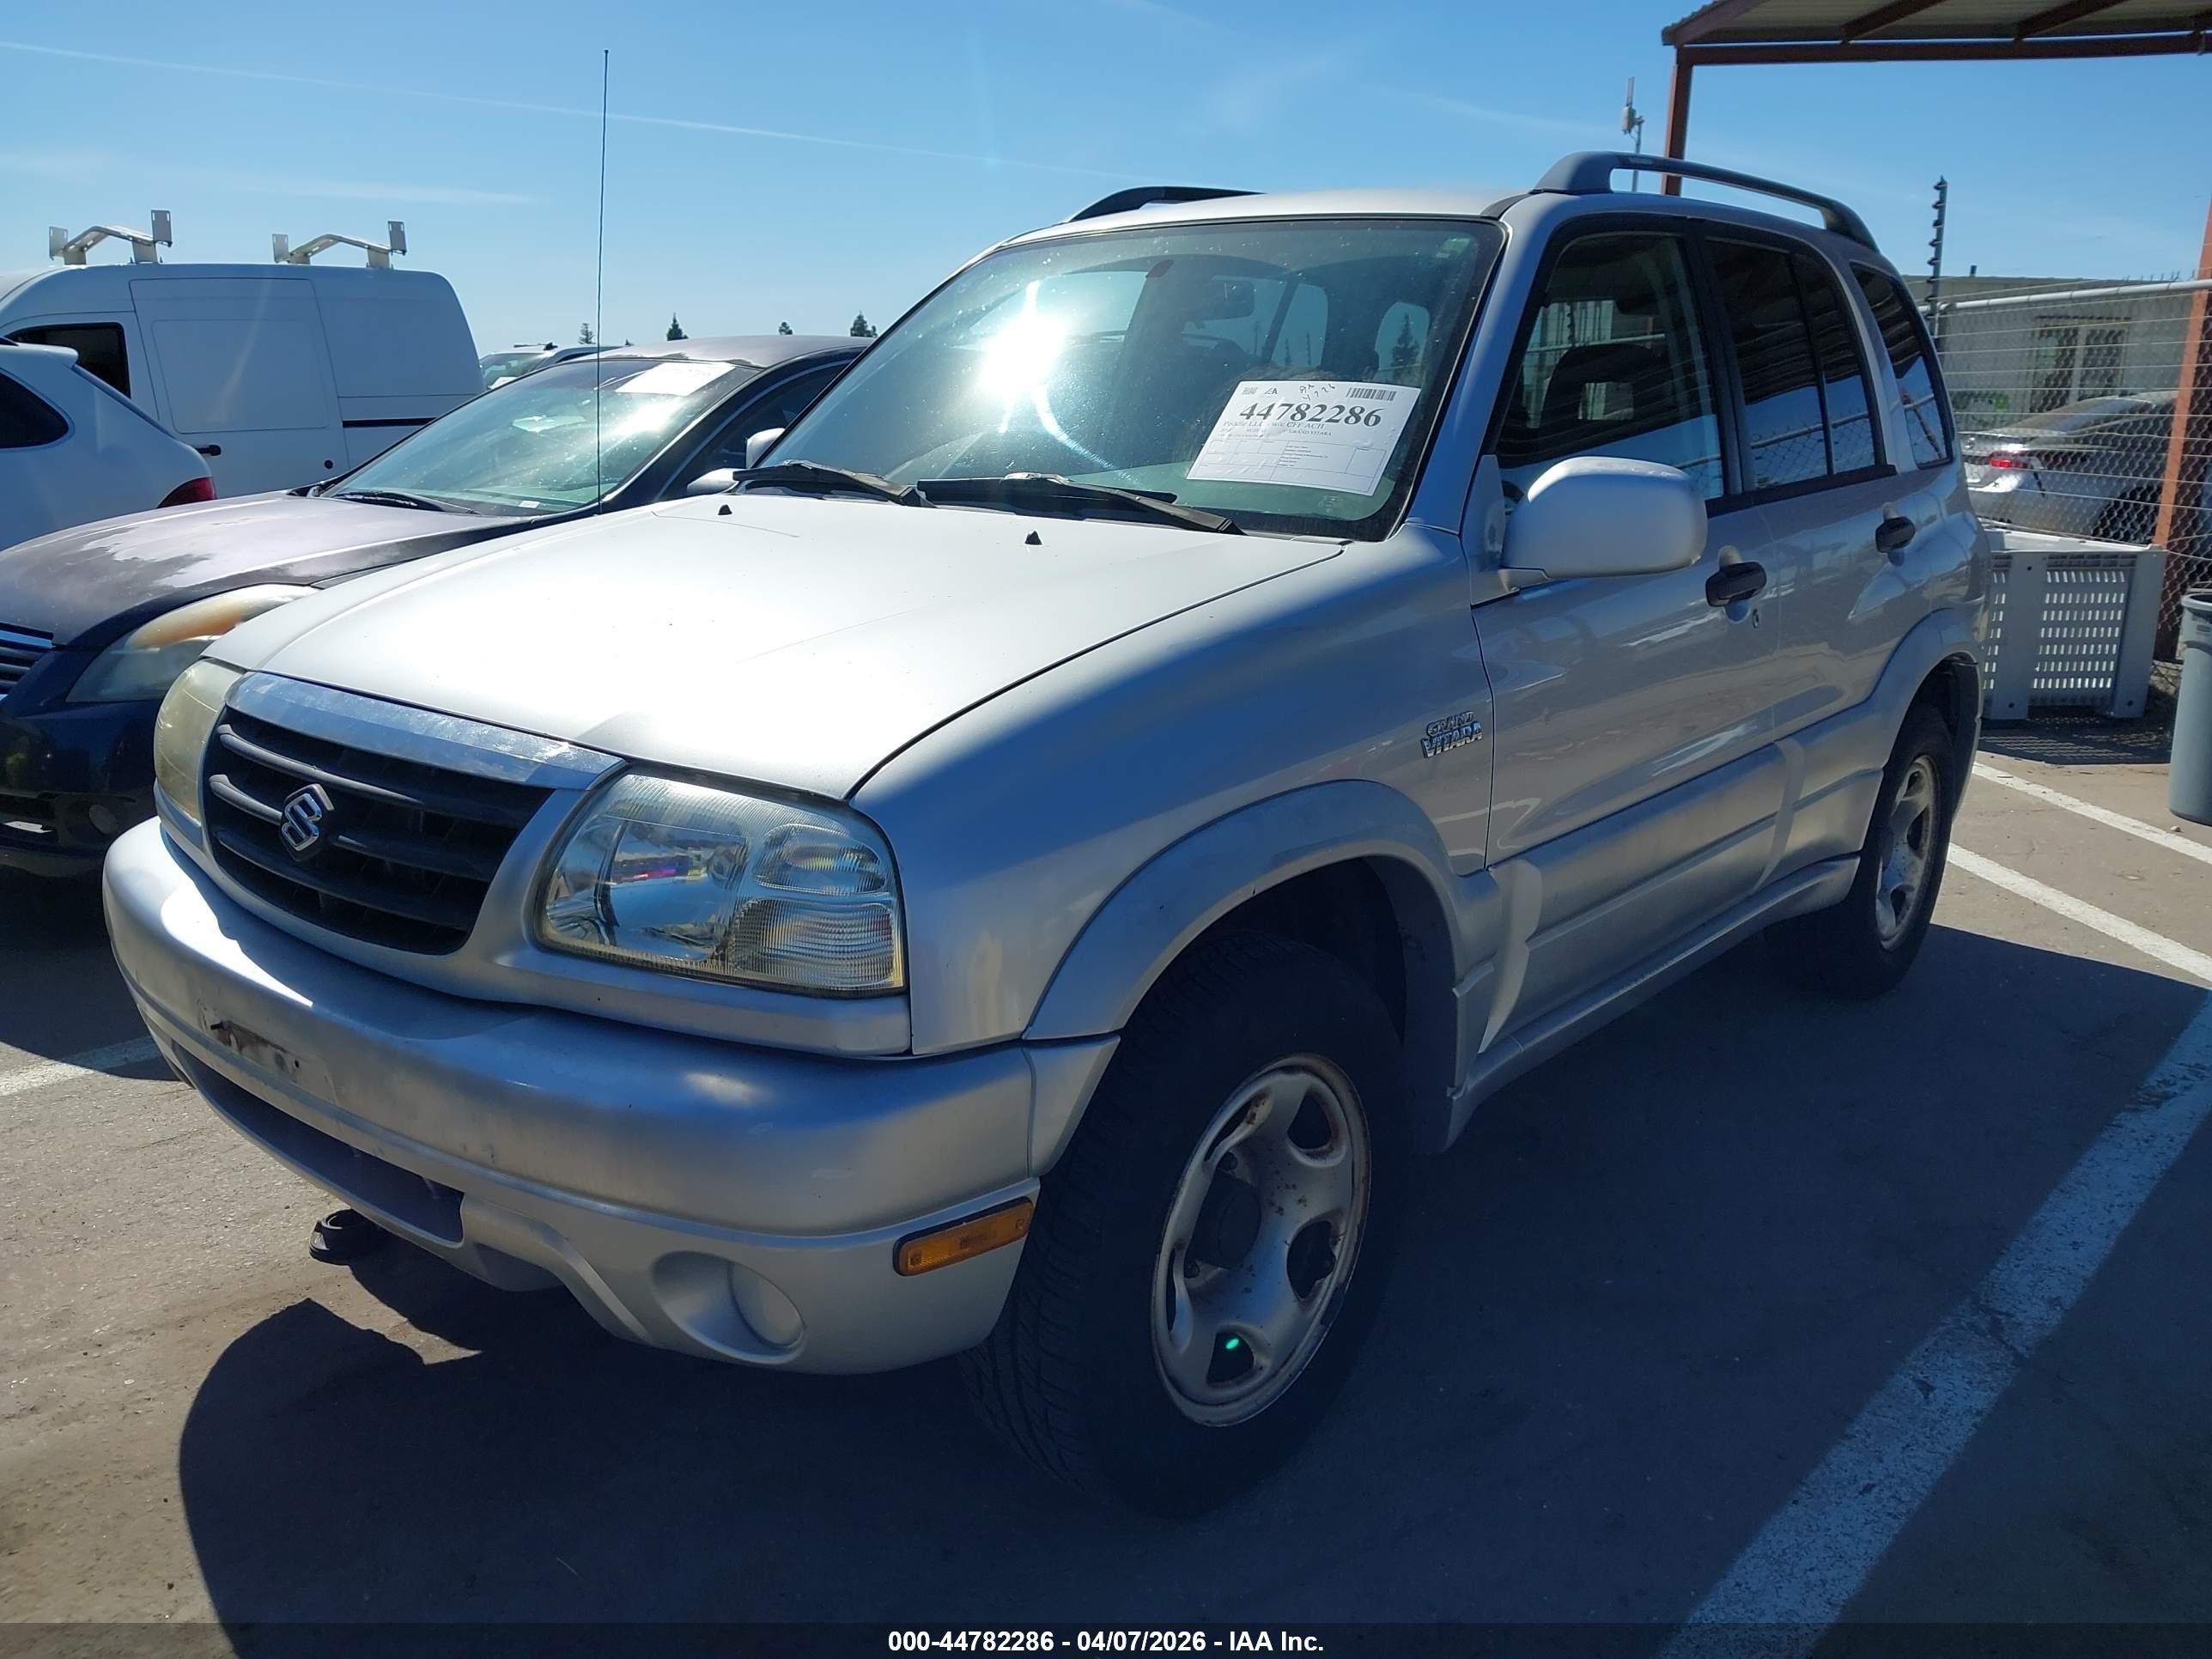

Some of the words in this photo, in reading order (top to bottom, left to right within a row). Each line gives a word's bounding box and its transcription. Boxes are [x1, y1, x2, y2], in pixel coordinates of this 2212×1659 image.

[1239, 402, 1385, 427] 44782286
[1426, 710, 1474, 738] GRAND
[1421, 721, 1483, 758] VITARA
